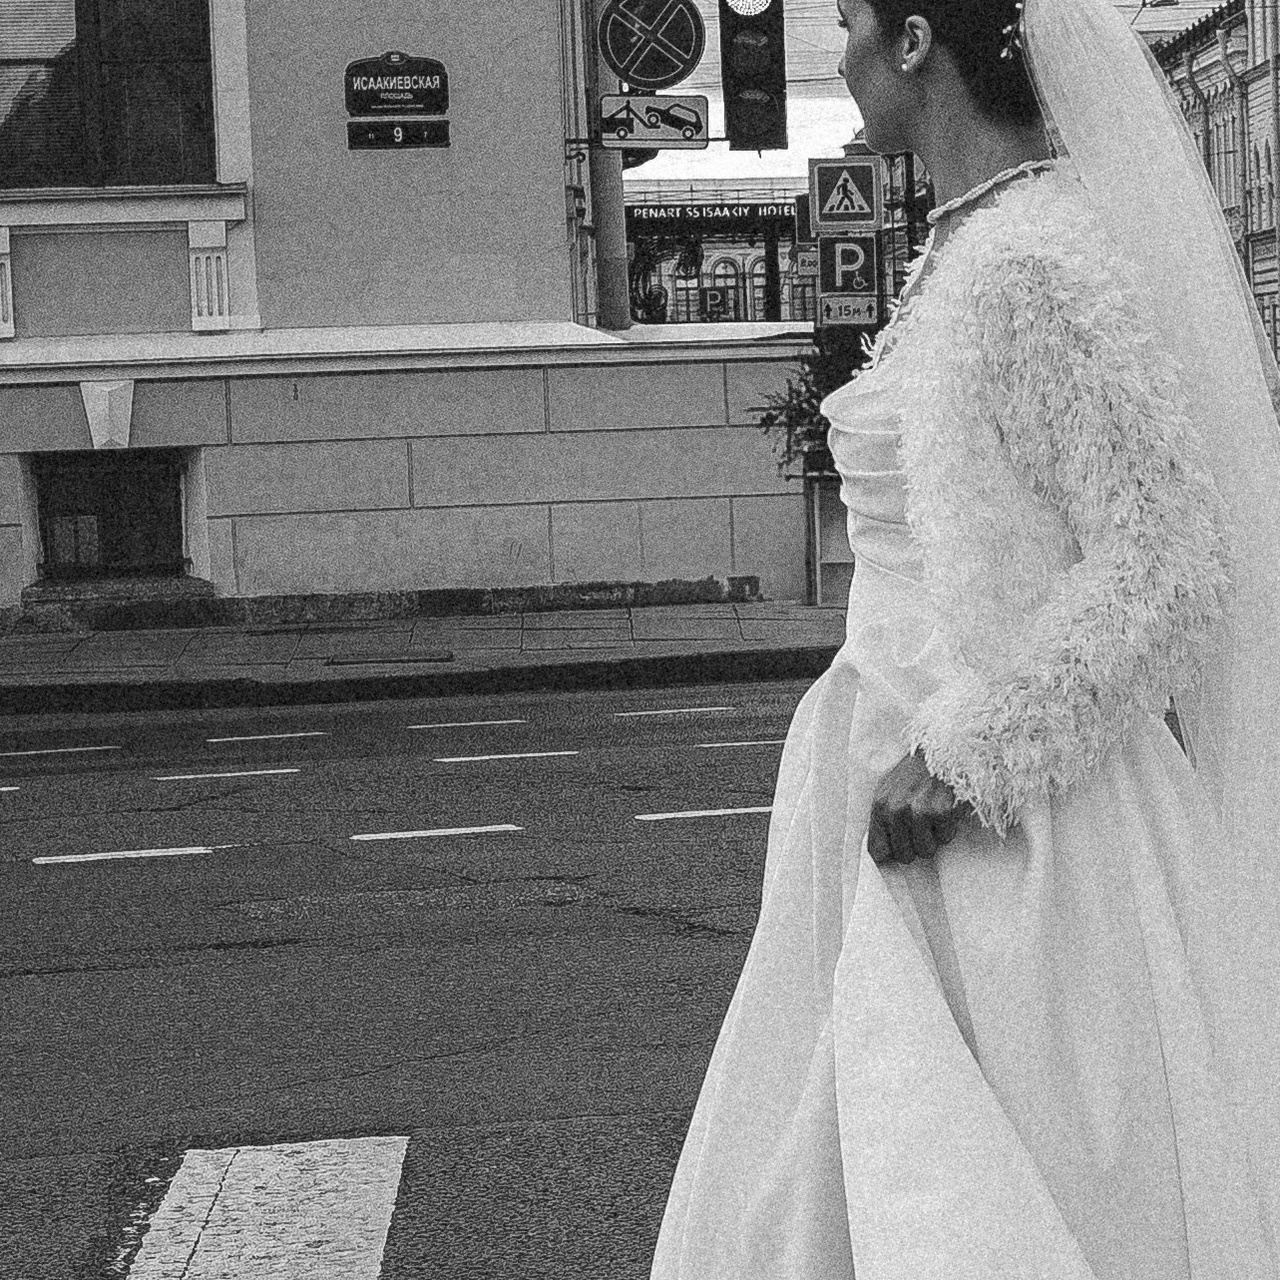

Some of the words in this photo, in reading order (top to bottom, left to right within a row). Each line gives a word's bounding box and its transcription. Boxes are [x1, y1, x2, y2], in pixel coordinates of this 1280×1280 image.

[353, 75, 440, 90] ИСААКИЕВСКАЯ
[393, 127, 403, 142] 9
[758, 205, 796, 216] HOTEL
[835, 243, 865, 286] P
[707, 290, 721, 311] P
